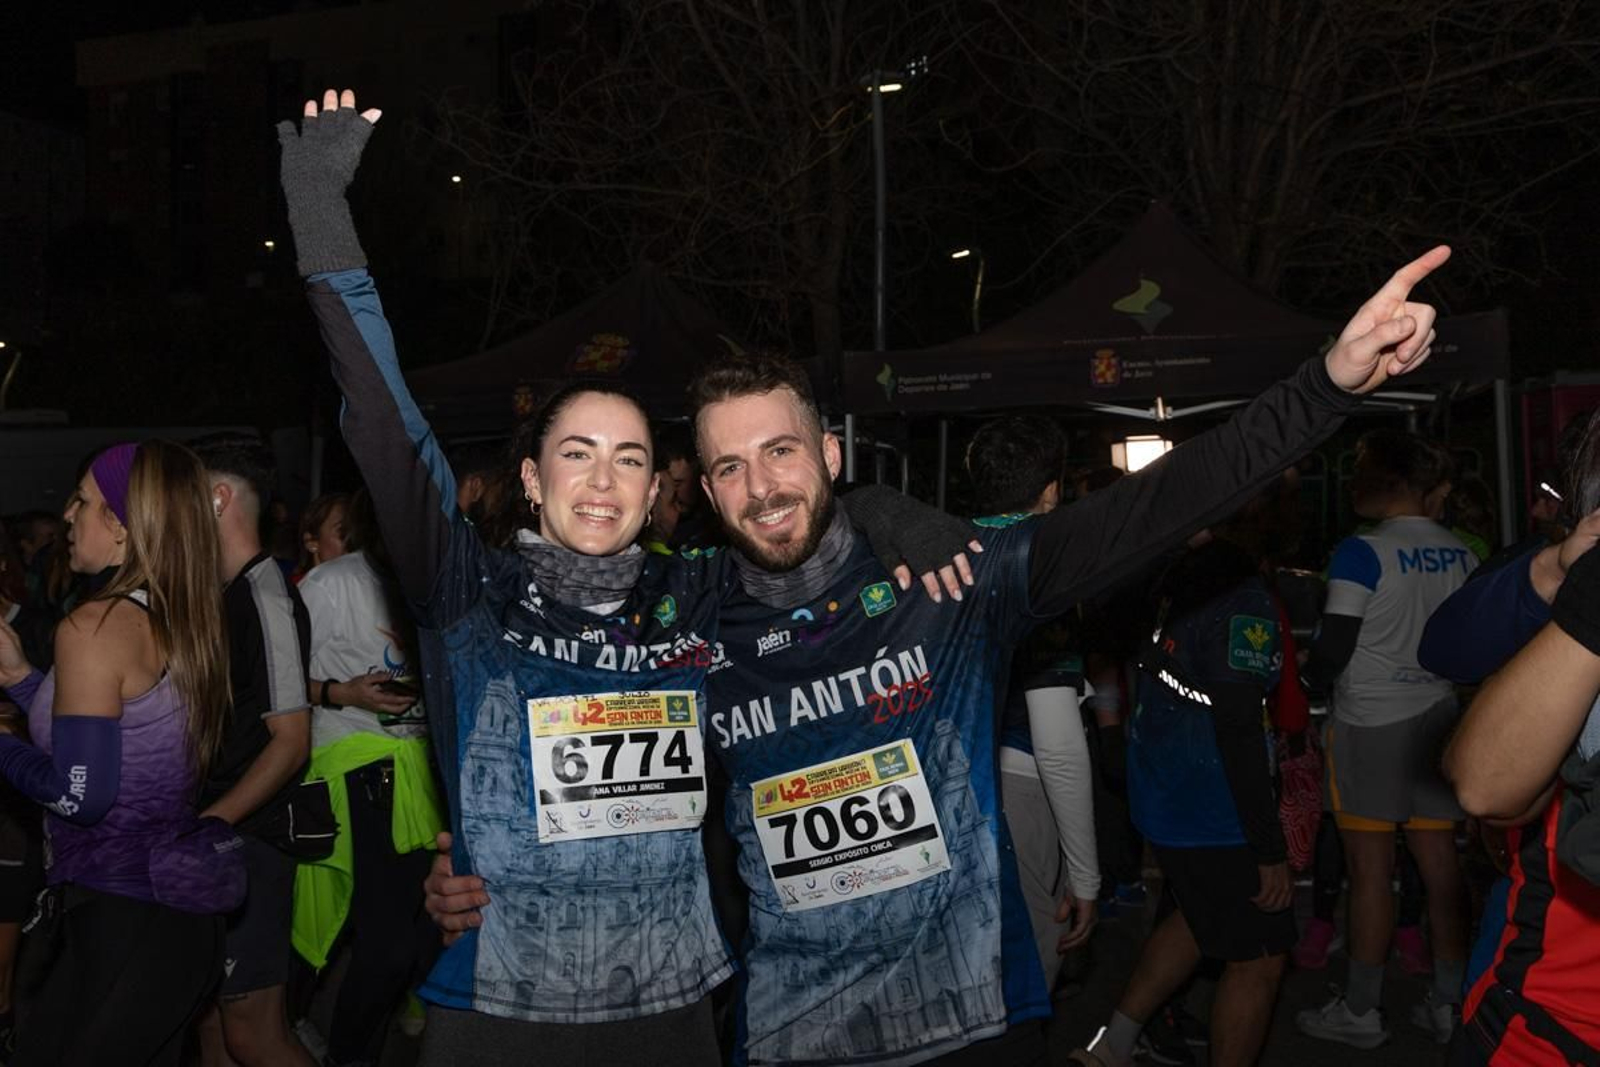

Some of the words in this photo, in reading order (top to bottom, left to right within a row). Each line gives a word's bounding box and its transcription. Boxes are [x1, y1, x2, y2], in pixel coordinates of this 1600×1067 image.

[1397, 548, 1468, 574] MSPT
[710, 696, 777, 749] SAN
[788, 644, 932, 727] ANTÓN
[866, 673, 936, 725] 2025
[573, 700, 606, 727] 42
[606, 711, 628, 724] SAN
[551, 730, 693, 785] 6774
[592, 786, 610, 796] ANA
[612, 784, 637, 795] VILLAR
[778, 777, 811, 803] 42
[810, 782, 834, 796] SAN
[768, 785, 916, 859] 7060
[808, 856, 833, 869] SERGIO
[835, 846, 870, 862] EXPÓSITO
[871, 840, 894, 853] CHICA
